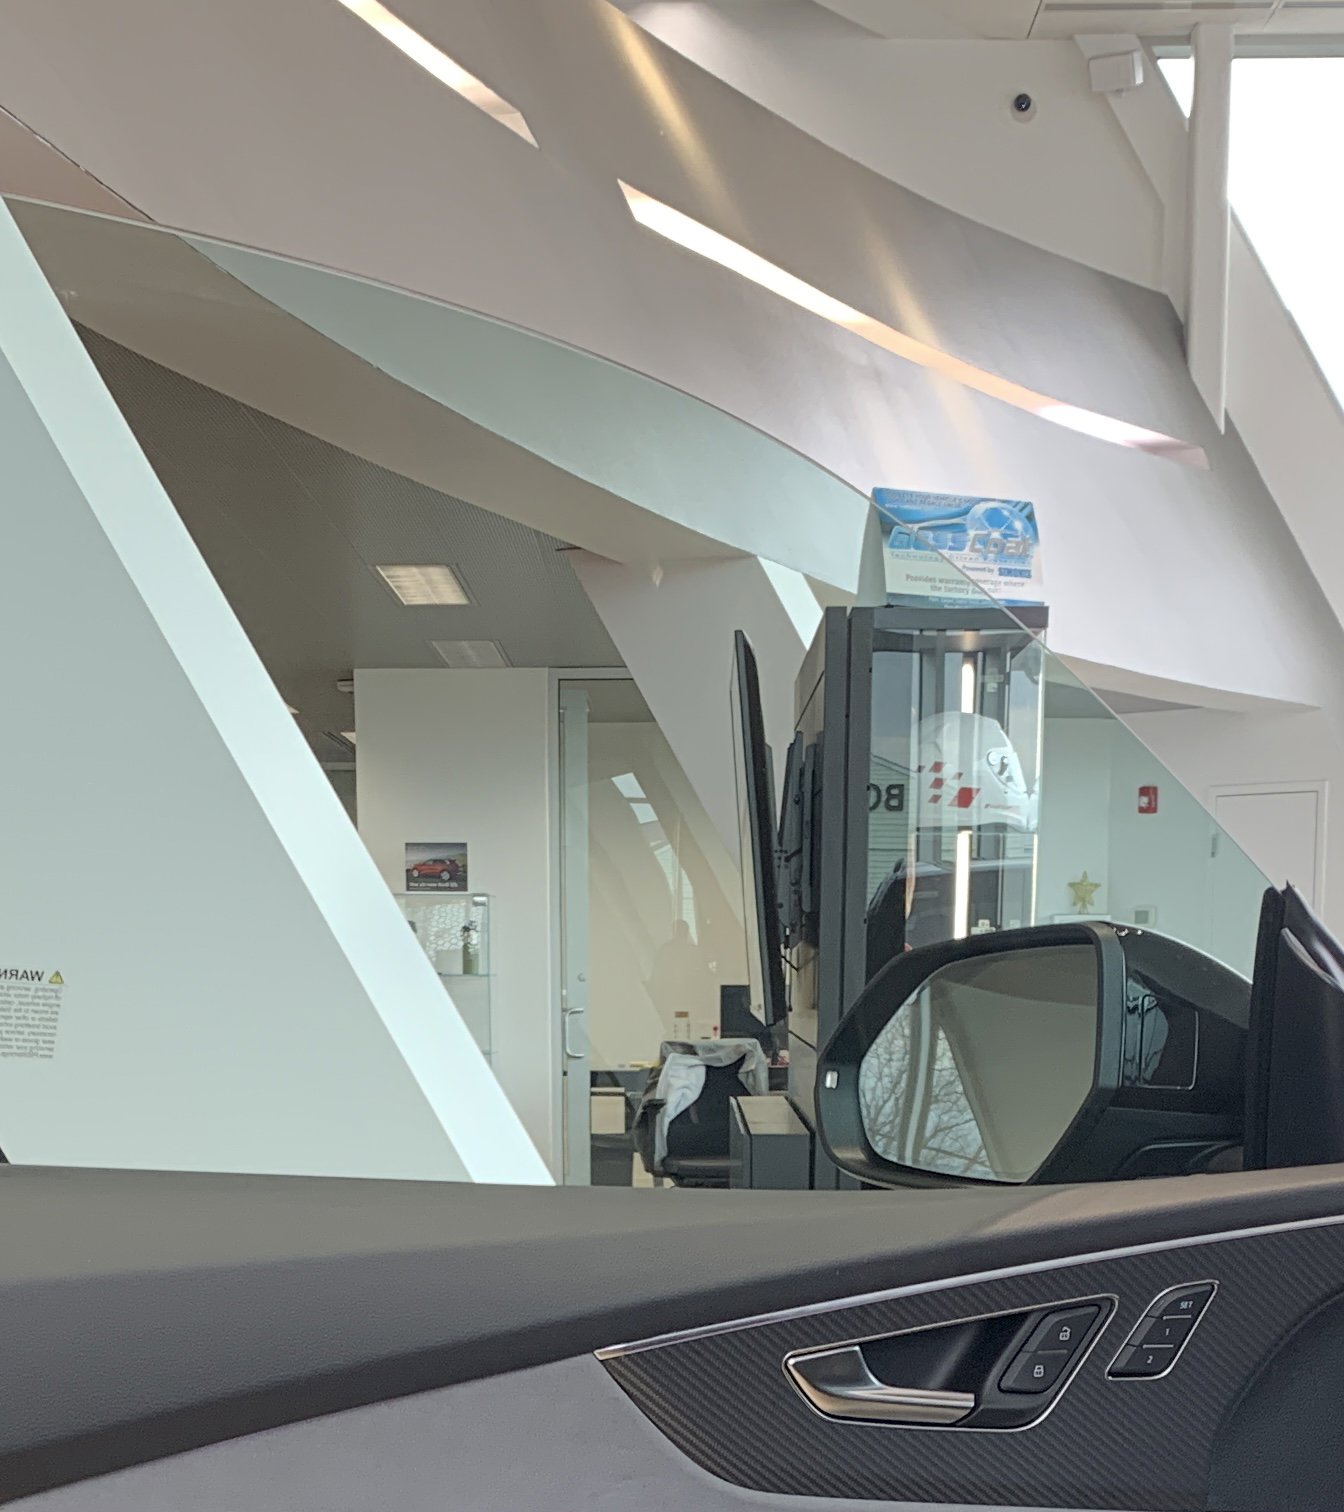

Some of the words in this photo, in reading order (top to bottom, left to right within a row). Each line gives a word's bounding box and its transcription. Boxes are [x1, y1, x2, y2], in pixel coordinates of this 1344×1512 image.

[1179, 1300, 1193, 1309] SET
[1165, 1328, 1170, 1336] 1
[1147, 1355, 1153, 1364] 2
